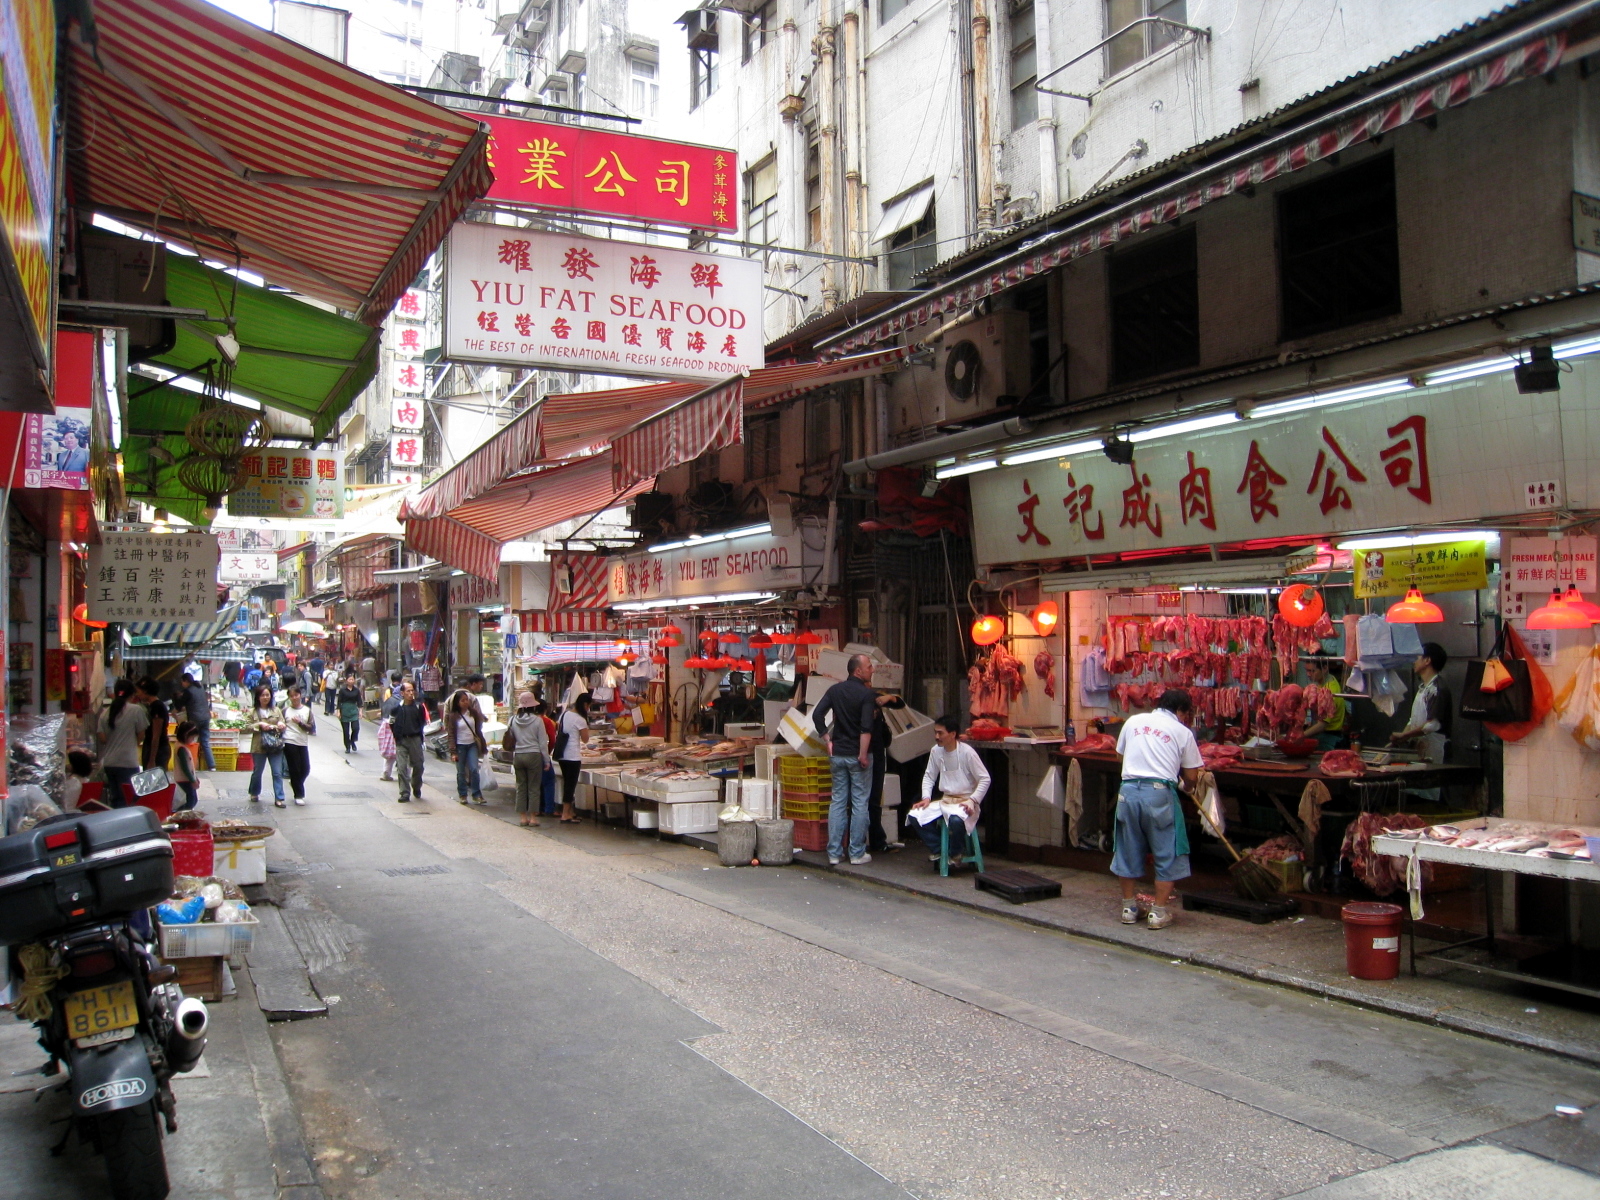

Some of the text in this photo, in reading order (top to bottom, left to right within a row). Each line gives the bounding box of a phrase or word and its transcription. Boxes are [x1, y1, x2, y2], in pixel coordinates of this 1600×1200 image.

[498, 239, 723, 299] 耀發海鮮
[471, 280, 746, 330] YIU FAT SEAFOOD
[477, 310, 738, 358] 經營各國優質海產
[464, 338, 486, 351] THE
[490, 339, 517, 353] BEST
[520, 343, 535, 354] OF
[539, 344, 620, 363] INTERNATIONAL
[625, 352, 657, 366] FRESH
[661, 357, 704, 372] SEAFOOD
[395, 292, 421, 484] 勝興凍肉糧
[1016, 414, 1432, 546] 文記成肉食公司
[229, 556, 270, 570] 文記
[1415, 548, 1459, 565] 五豐鮮肉
[1511, 554, 1535, 562] FRESH
[1536, 554, 1556, 562] MEA
[1575, 553, 1595, 561] SALE
[98, 566, 165, 584] 鍾百崇
[181, 568, 207, 579] 全科
[680, 560, 696, 581] YIU
[701, 557, 719, 579] FAT
[1517, 568, 1587, 581] 新鮮肉出售
[97, 586, 164, 604] 王濟康
[181, 582, 206, 592] 針灸
[179, 595, 206, 605] 跌打
[82, 987, 116, 1010] HT
[75, 1004, 129, 1032] 8611
[85, 1079, 142, 1104] HONDA
